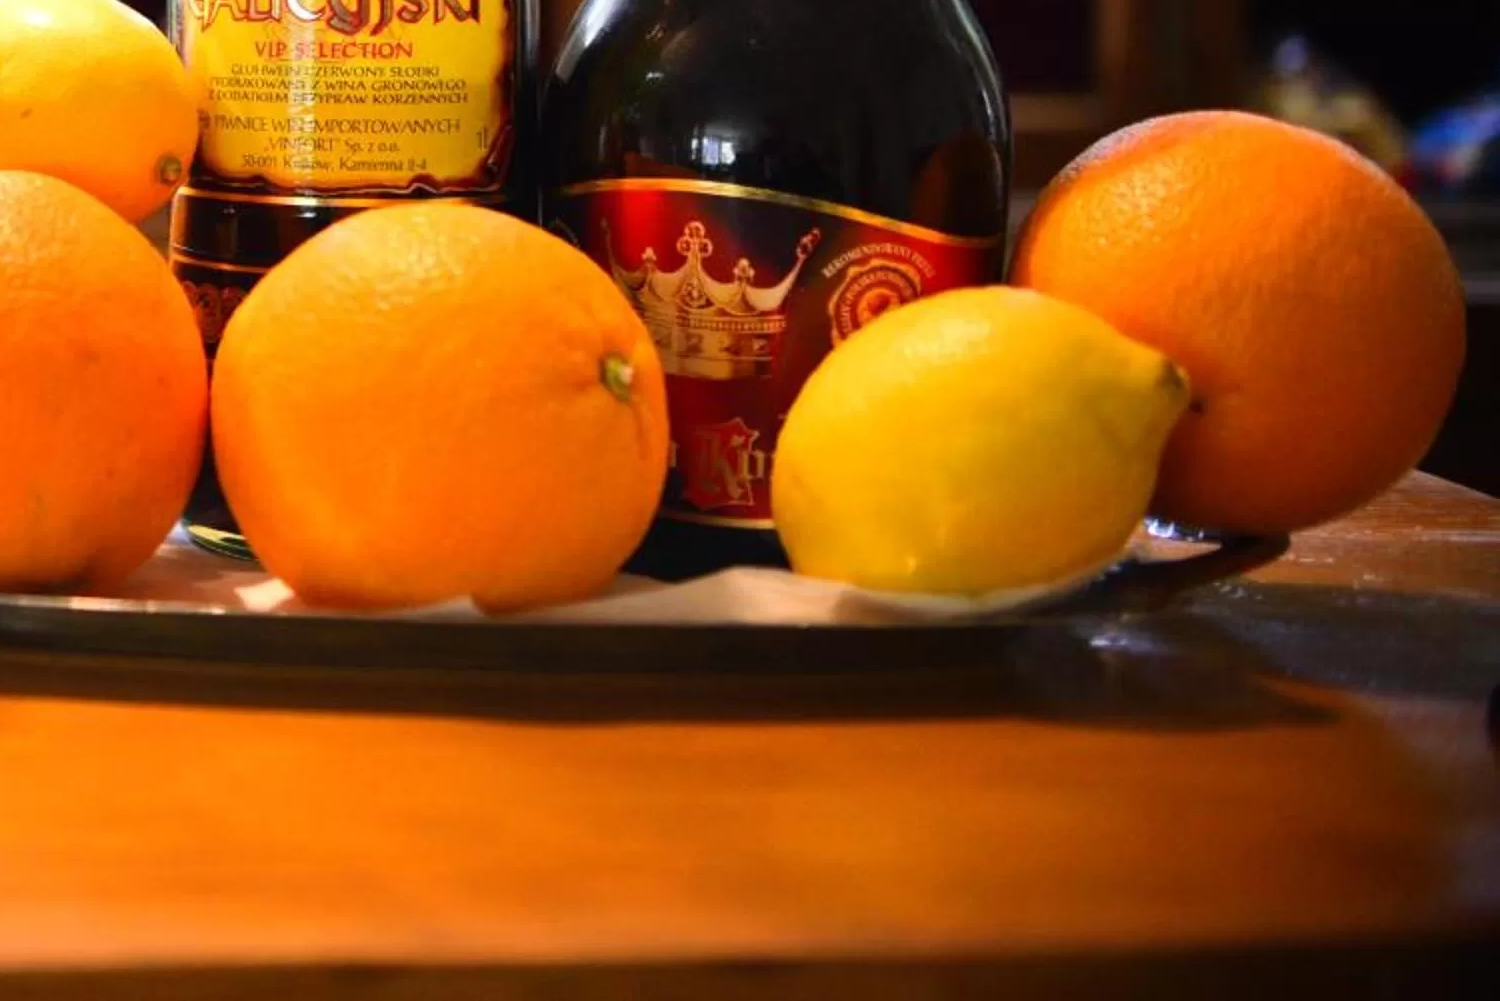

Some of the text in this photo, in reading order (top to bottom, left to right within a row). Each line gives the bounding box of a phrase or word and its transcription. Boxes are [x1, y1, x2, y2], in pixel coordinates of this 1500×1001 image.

[255, 42, 287, 59] VIP
[324, 80, 367, 91] WINA
[371, 79, 467, 91] GRONOWEGO
